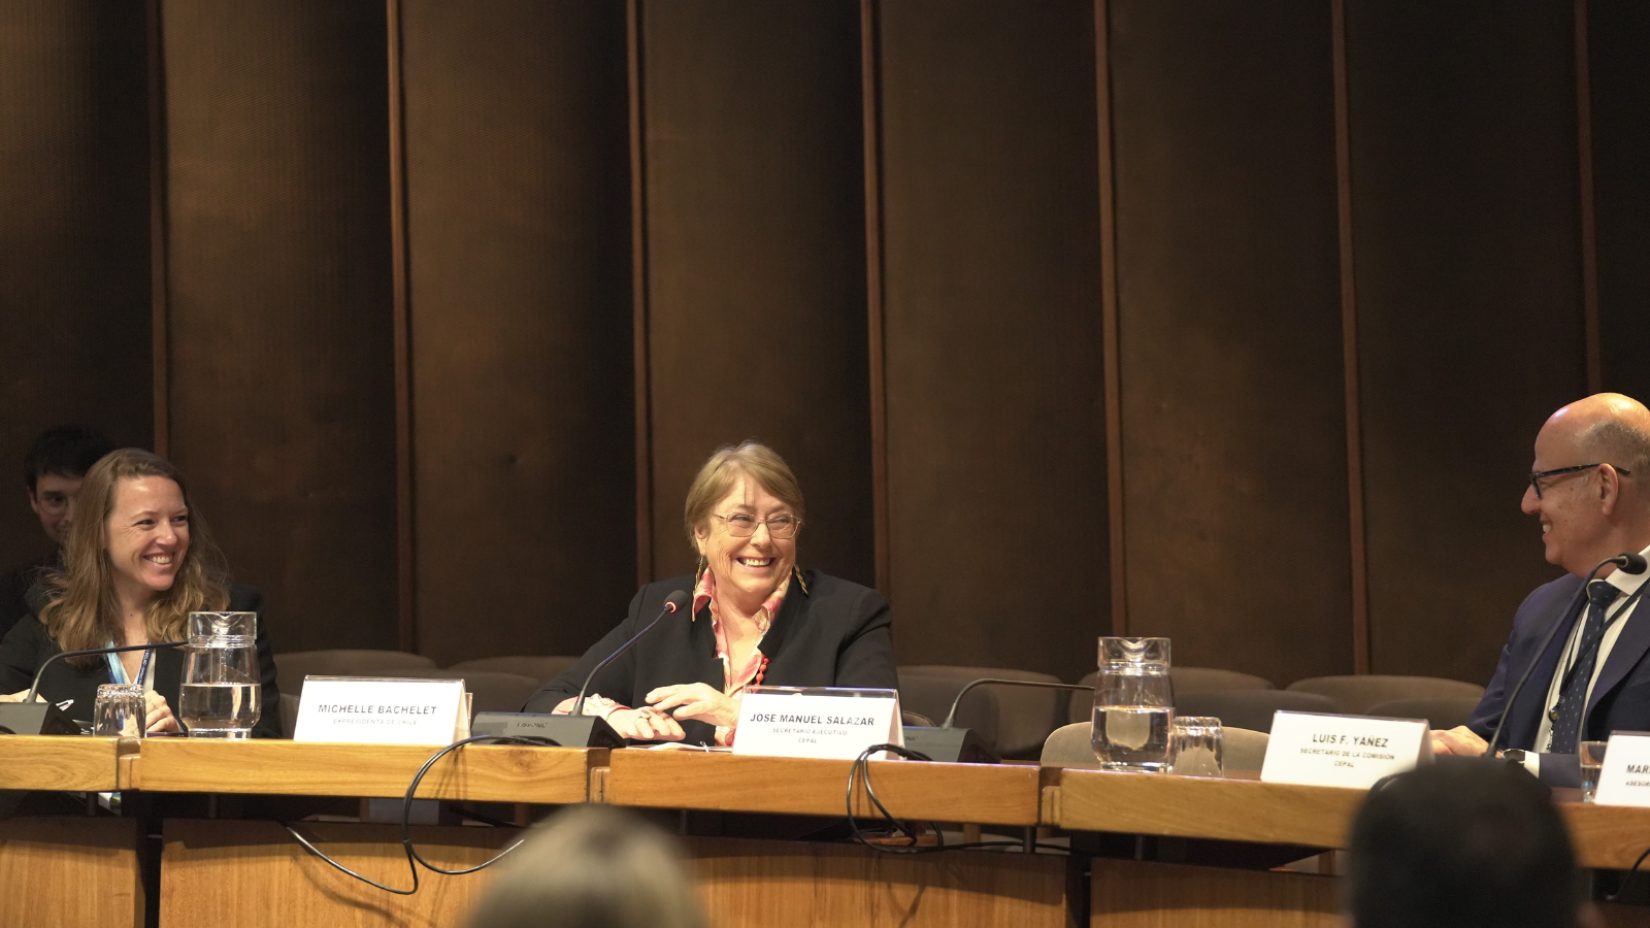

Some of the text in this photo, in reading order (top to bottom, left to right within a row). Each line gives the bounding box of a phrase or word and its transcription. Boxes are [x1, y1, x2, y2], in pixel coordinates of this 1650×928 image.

[318, 704, 437, 715] MICHELLE BACHELET
[750, 713, 875, 726] JOSE MANUEL SALAZAR
[772, 727, 848, 736] SECRETARIO EJECUTIVO
[1312, 733, 1389, 748] LUIS F. YAÑEZ
[1300, 748, 1340, 757] SECRETARIO
[1341, 750, 1351, 758] DE
[1334, 760, 1354, 768] CEPAL
[1626, 764, 1650, 774] MAR
